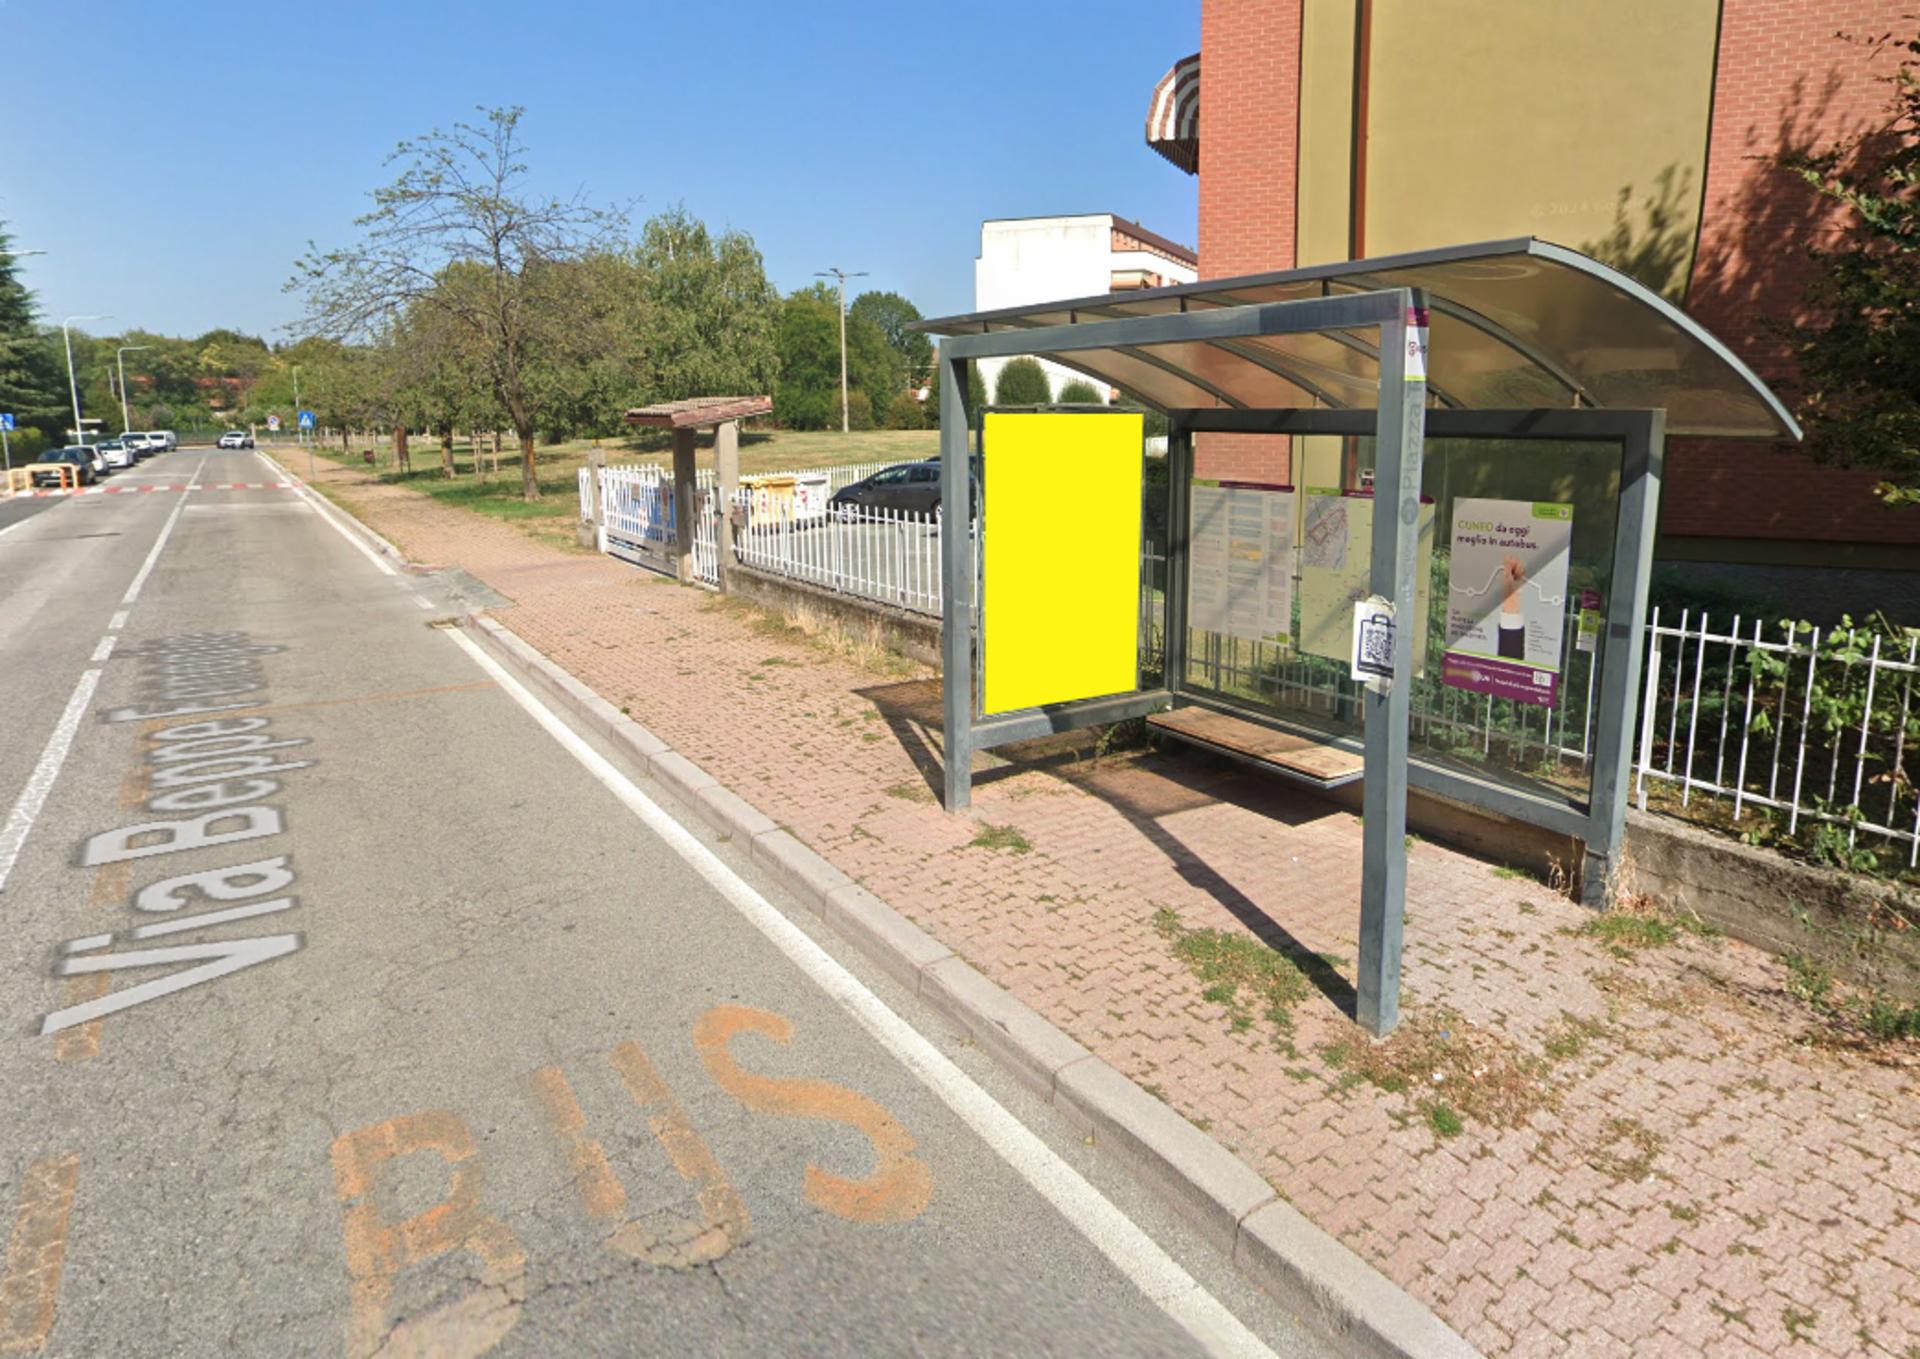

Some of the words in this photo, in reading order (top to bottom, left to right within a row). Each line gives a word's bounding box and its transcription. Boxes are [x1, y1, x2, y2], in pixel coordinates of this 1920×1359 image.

[1402, 403, 1421, 490] Piazza
[1456, 533, 1487, 547] meglio
[1488, 536, 1498, 546] in
[1457, 519, 1494, 532] CUNEO
[1495, 522, 1507, 533] da
[1508, 525, 1531, 538] oggi
[331, 1004, 933, 1359] BUS
